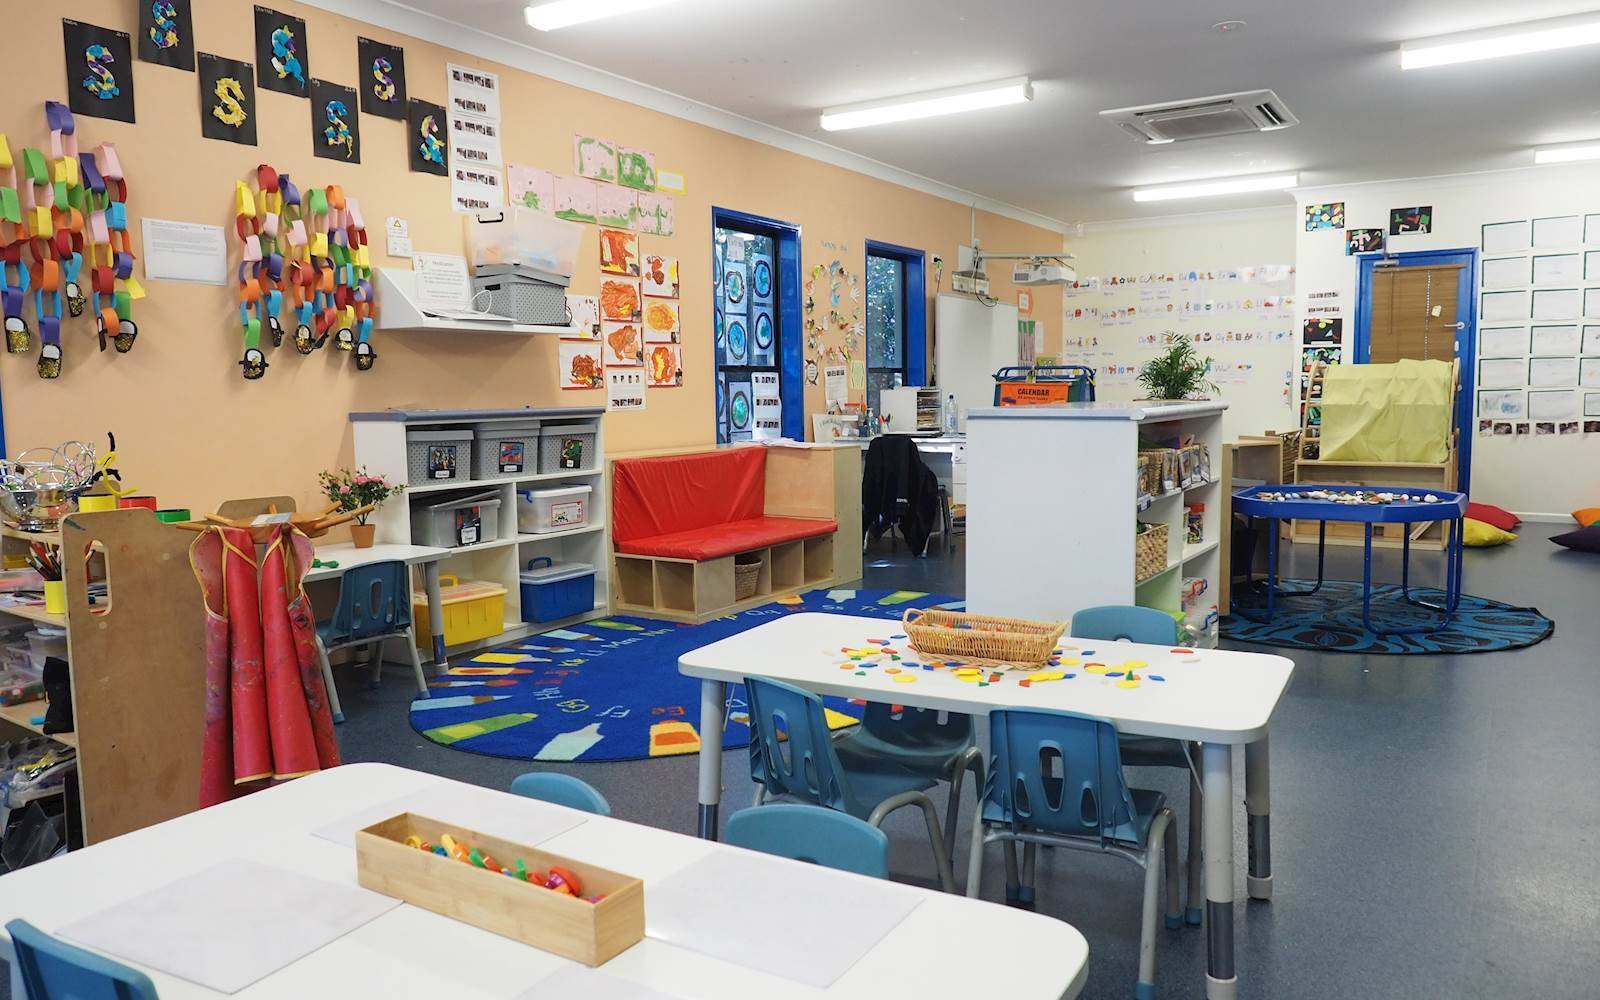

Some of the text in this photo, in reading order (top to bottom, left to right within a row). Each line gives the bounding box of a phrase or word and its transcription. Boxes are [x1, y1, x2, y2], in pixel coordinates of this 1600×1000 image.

[83, 44, 120, 100] S
[373, 56, 398, 103] S
[213, 77, 249, 128] S
[1017, 388, 1050, 396] CALENDAR
[596, 704, 631, 719] Ff
[651, 705, 686, 717] Ee
